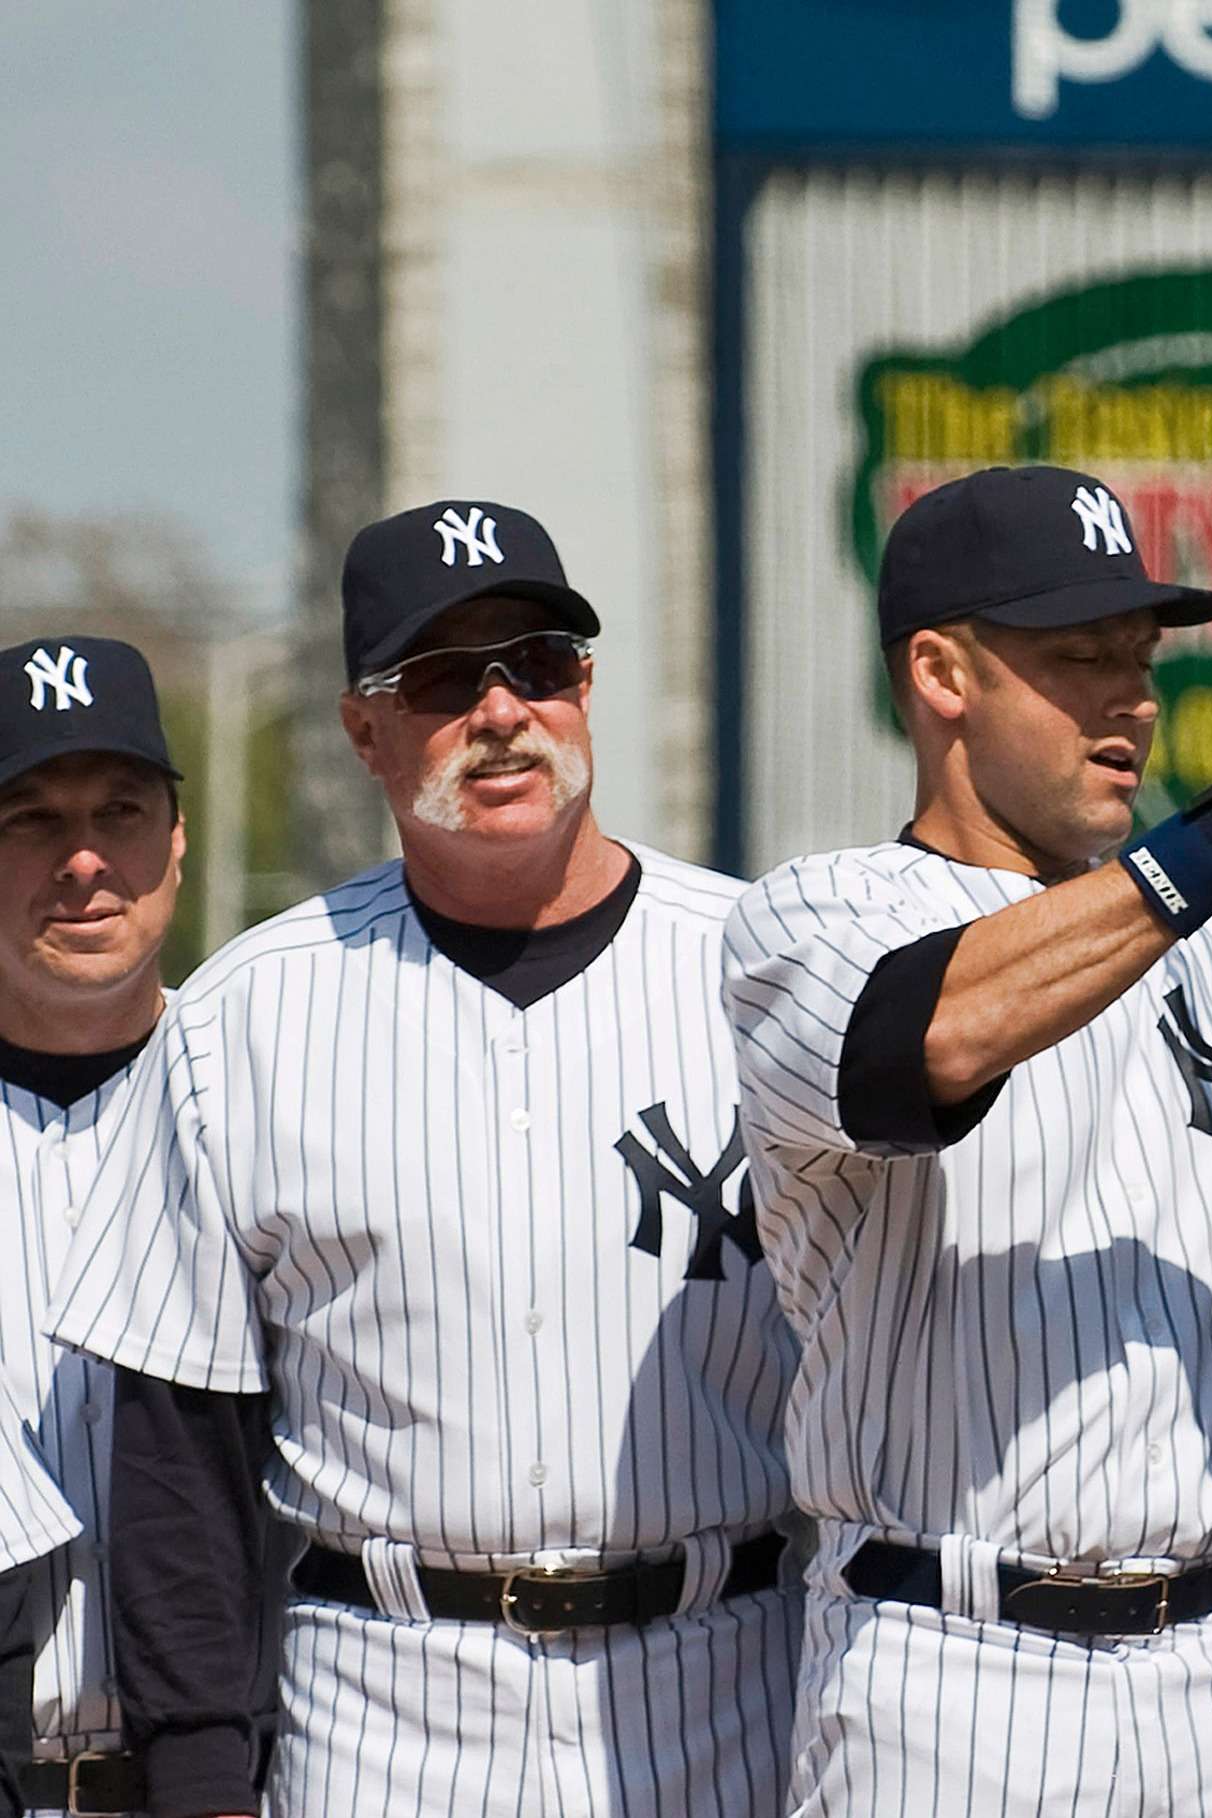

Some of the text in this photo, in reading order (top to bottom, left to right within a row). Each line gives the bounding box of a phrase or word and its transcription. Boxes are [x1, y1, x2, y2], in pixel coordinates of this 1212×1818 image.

[433, 507, 505, 567] NY
[1071, 486, 1134, 556] NY
[23, 646, 94, 711] NY
[613, 1101, 763, 1281] NY
